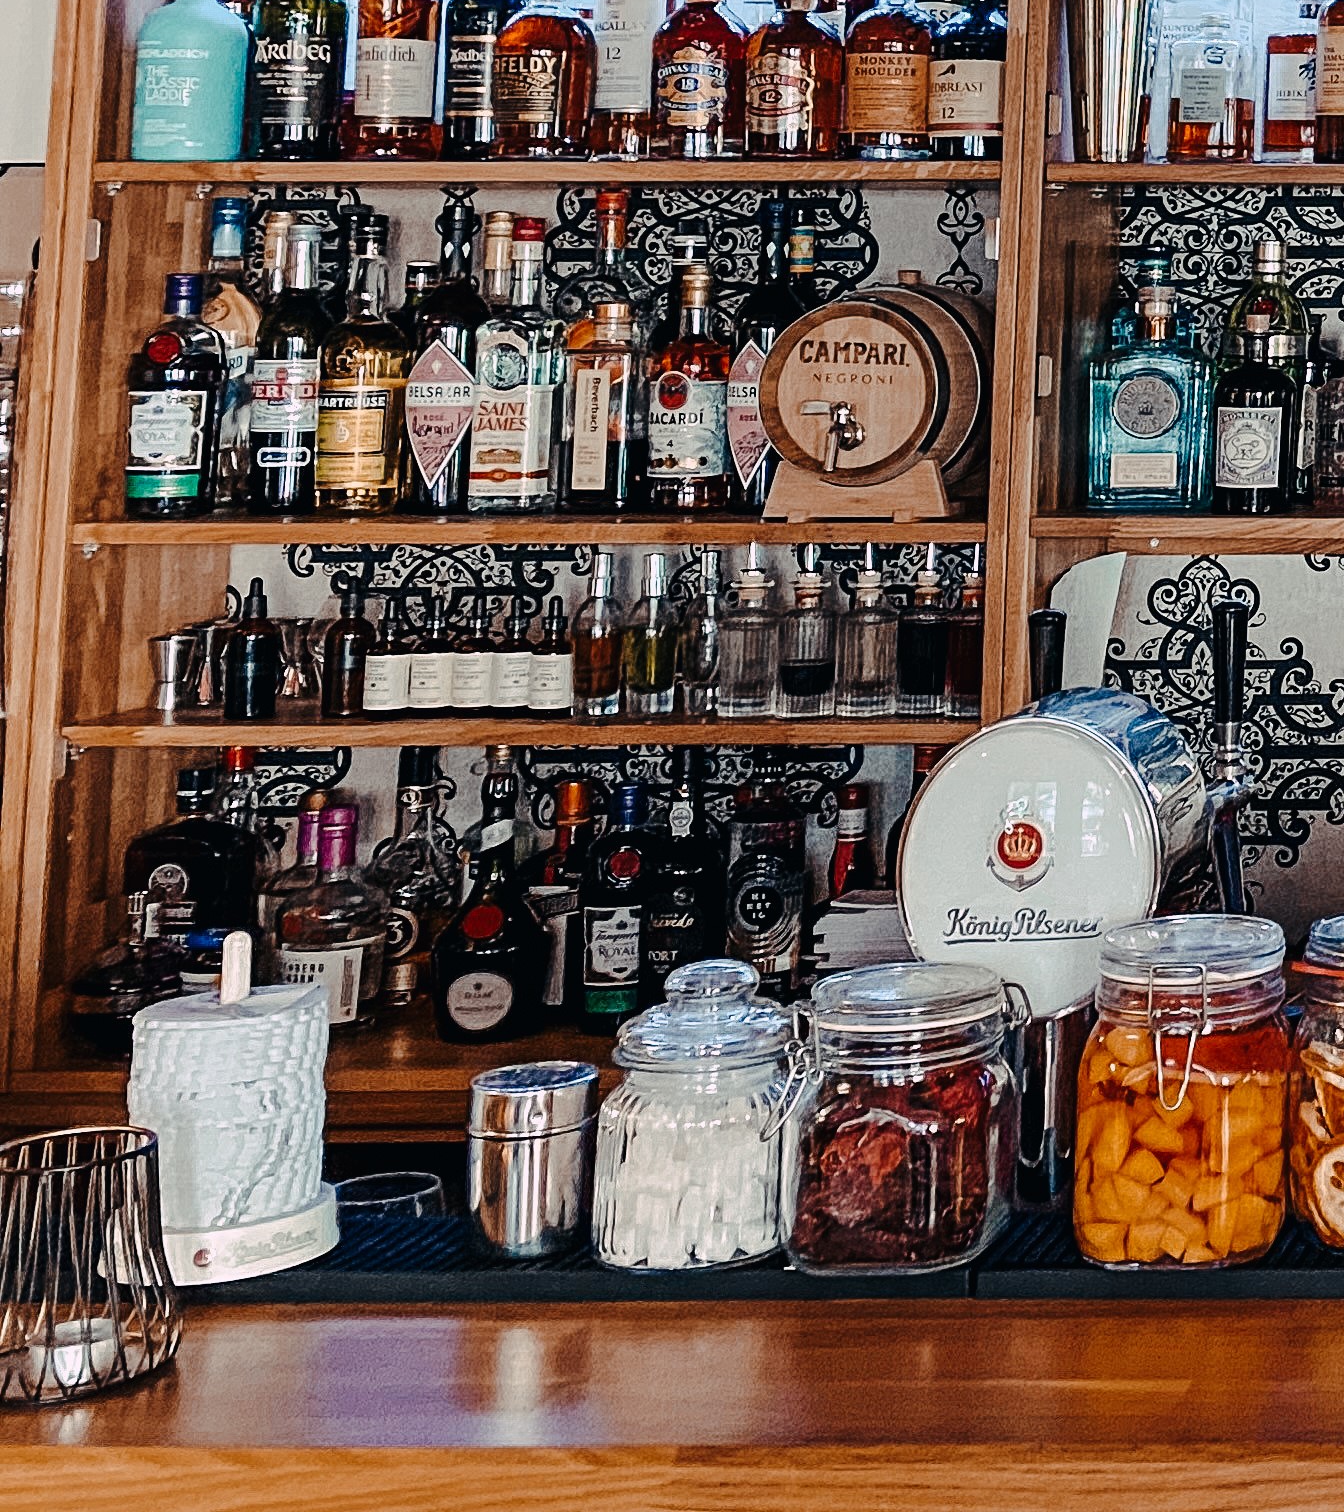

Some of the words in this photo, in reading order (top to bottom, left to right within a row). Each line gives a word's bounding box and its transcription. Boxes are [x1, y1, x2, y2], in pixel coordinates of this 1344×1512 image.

[606, 47, 621, 60] 12
[859, 55, 912, 66] MONKEY
[146, 65, 169, 77] THE
[854, 67, 917, 77] SHOULDER
[145, 78, 199, 89] CLASSIC
[1330, 74, 1340, 84] 12
[145, 89, 191, 101] LADDIE
[941, 107, 955, 119] 12
[813, 373, 894, 385] NEGRONI
[478, 401, 525, 416] SAINT
[590, 377, 602, 433] Beverbach
[474, 417, 528, 432] JAMES
[943, 908, 1012, 941] König
[1011, 908, 1102, 937] Pilsener
